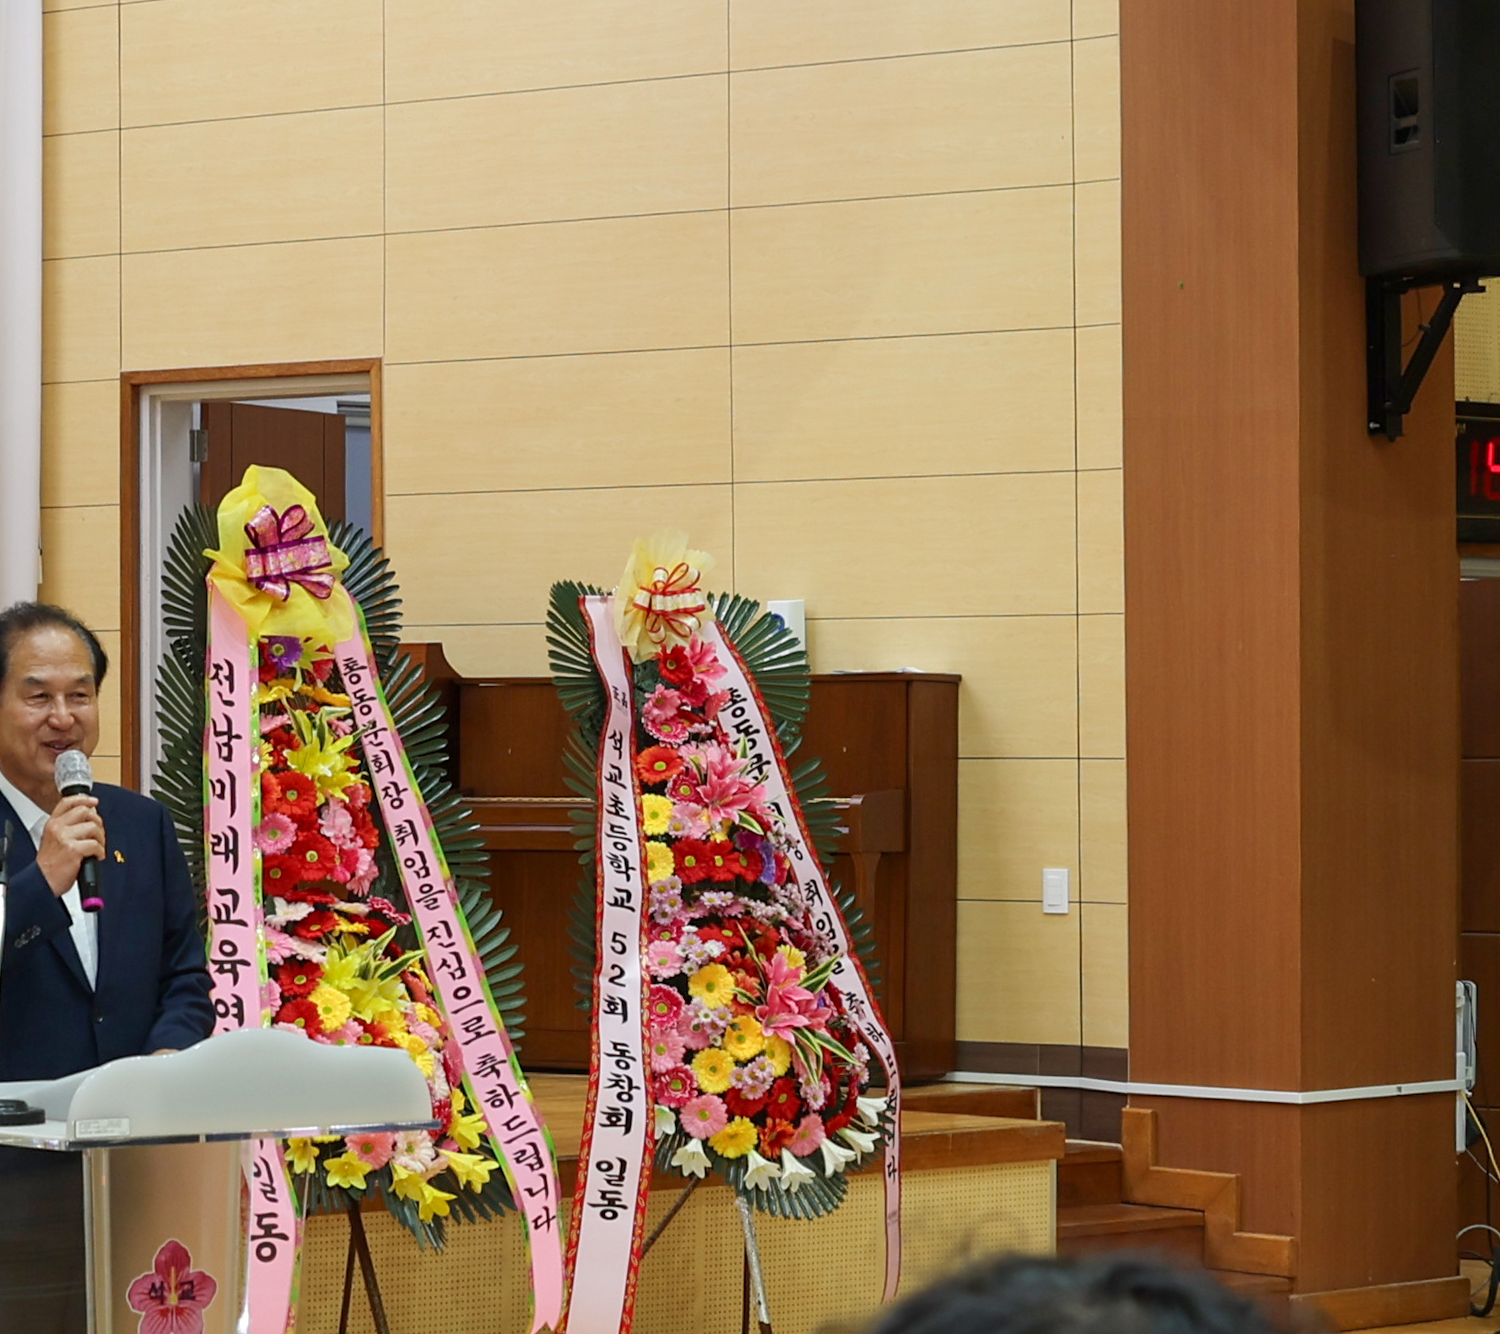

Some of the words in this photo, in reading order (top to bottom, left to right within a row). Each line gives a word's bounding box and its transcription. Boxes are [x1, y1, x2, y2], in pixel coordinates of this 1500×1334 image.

[603, 729, 637, 914] 석교초등학교
[342, 656, 408, 810] 총동문회장
[394, 819, 446, 910] 취임을
[426, 920, 497, 1046] 진심으로
[472, 1052, 558, 1235] 축하드립니다
[602, 930, 629, 1025] 52회
[598, 1039, 641, 1136] 동창회
[586, 1155, 629, 1221] 일동
